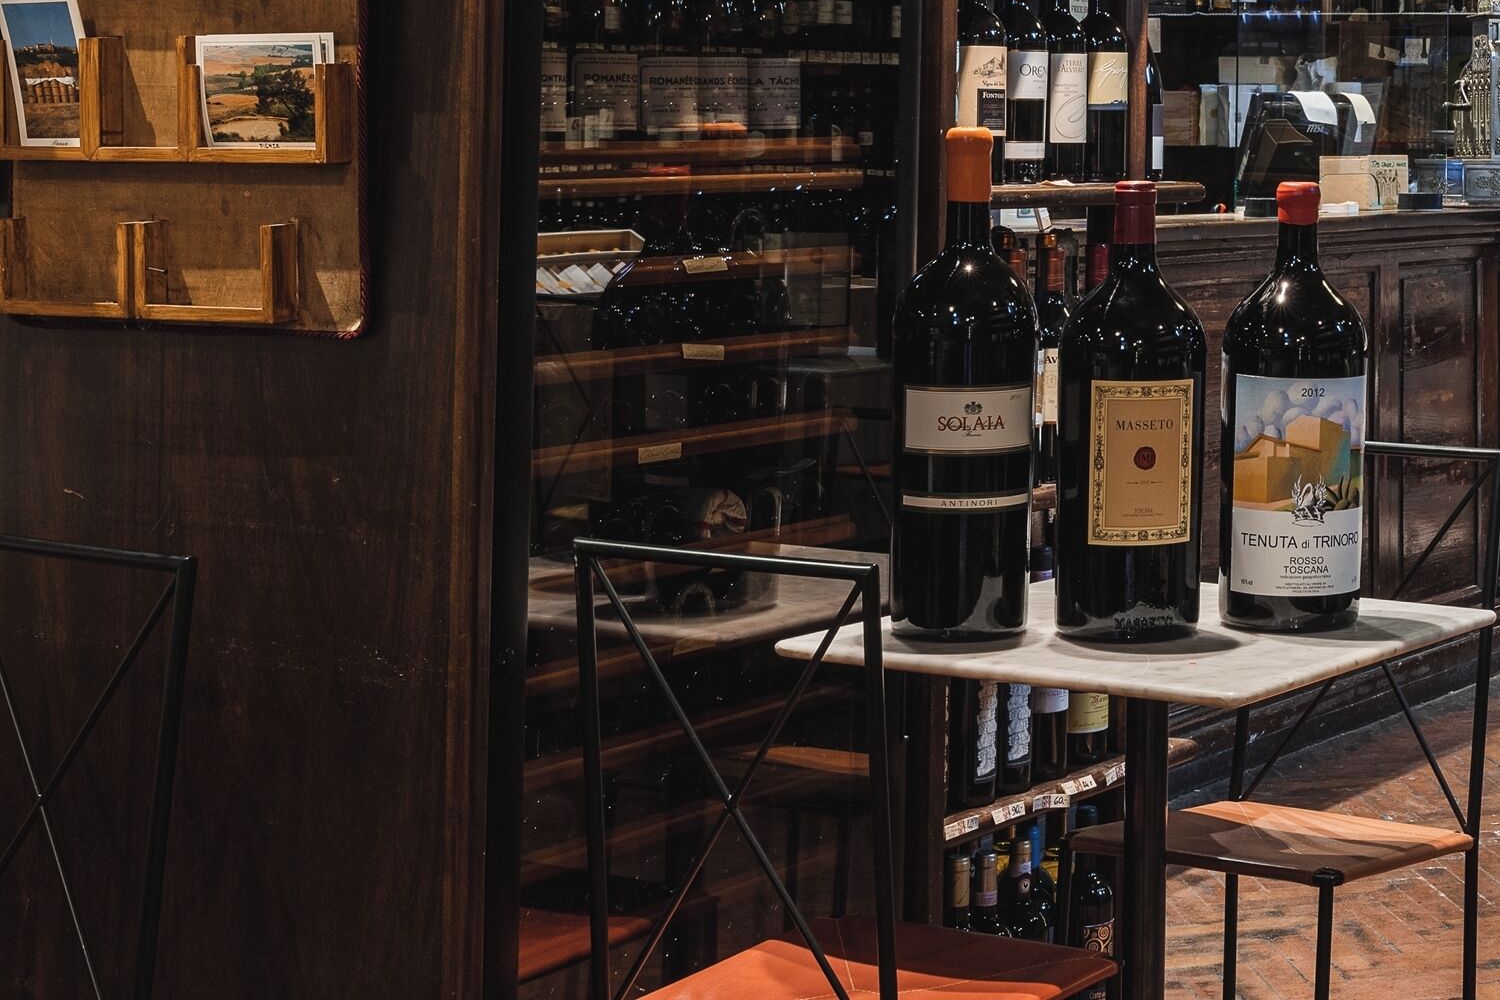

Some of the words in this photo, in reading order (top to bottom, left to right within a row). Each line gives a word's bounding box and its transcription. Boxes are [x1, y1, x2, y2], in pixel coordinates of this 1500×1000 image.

[1071, 5, 1083, 13] FREE
[1065, 59, 1083, 67] TERRE
[1301, 387, 1325, 398] 2012
[937, 414, 1006, 432] SOLAIA
[1115, 418, 1174, 431] MASSETO
[940, 499, 999, 507] ANTINORI
[1240, 531, 1298, 549] TENUTA
[1301, 539, 1310, 549] di
[1312, 530, 1359, 549] TRINORO
[1289, 556, 1324, 565] ROSSO
[1283, 565, 1329, 574] TOSCANA
